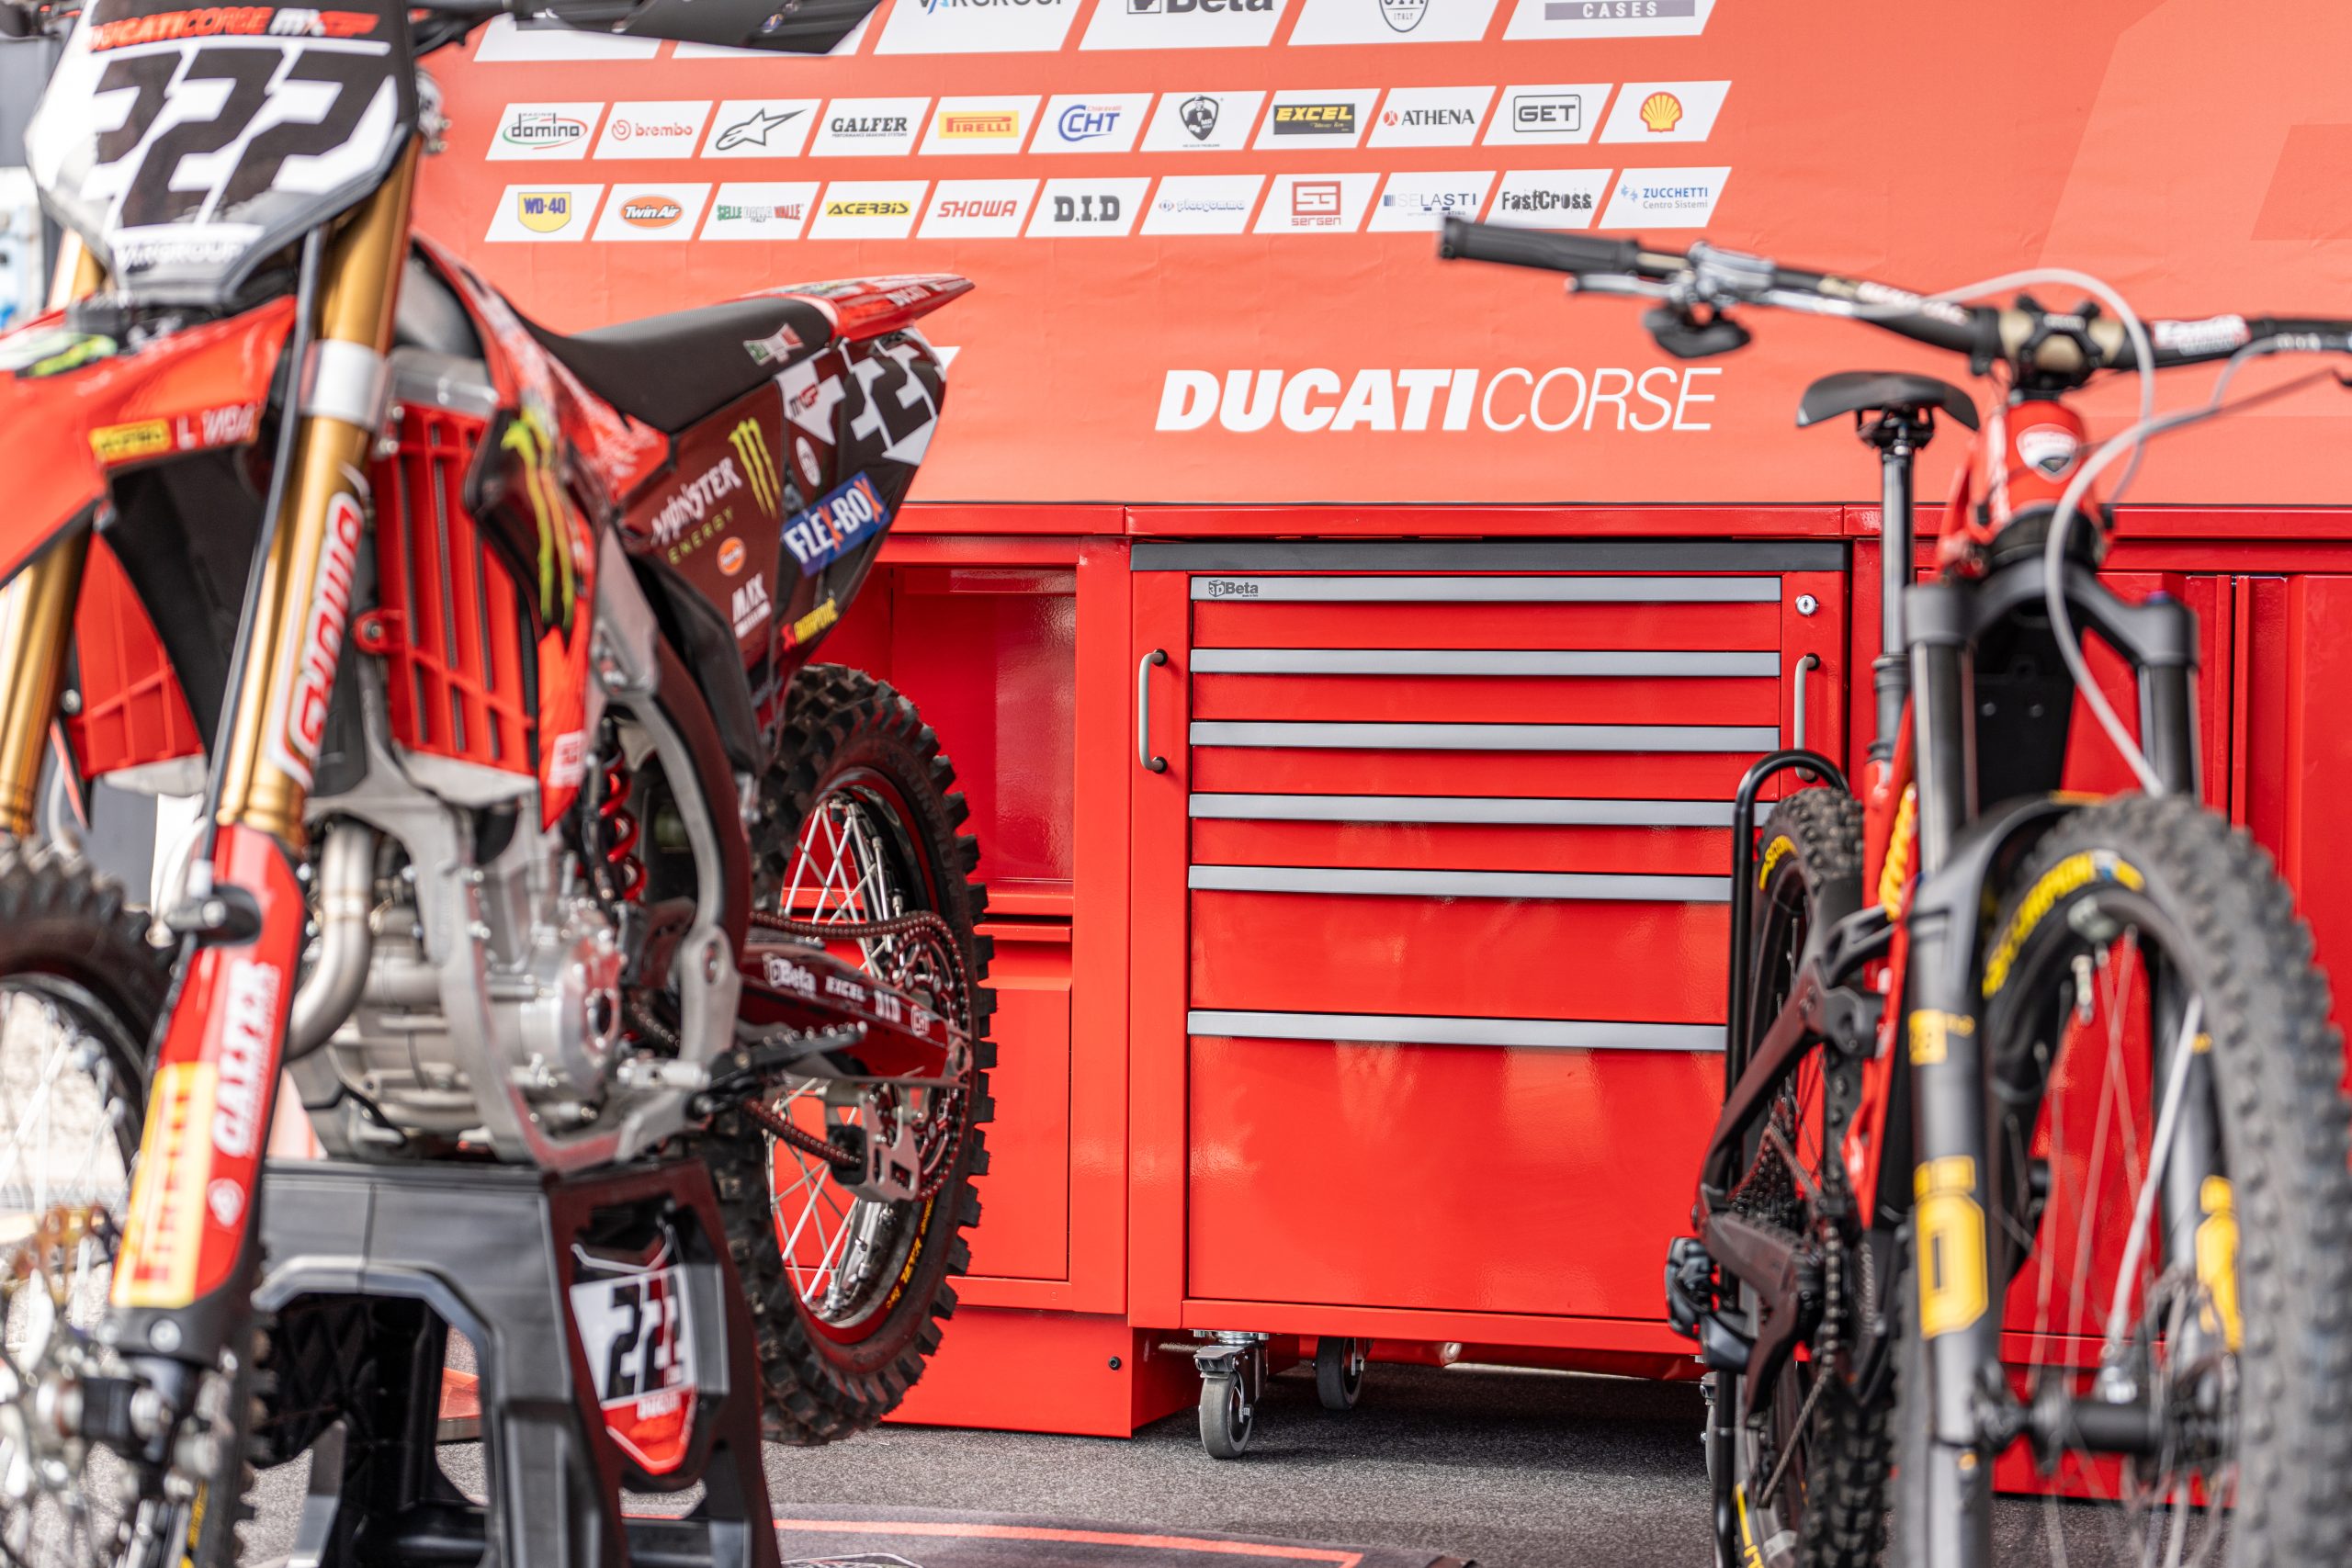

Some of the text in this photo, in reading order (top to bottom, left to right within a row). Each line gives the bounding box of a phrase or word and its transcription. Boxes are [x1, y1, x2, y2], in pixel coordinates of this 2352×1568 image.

[1582, 1, 1658, 18] CASES
[1275, 106, 1353, 121] EXCEL
[1401, 108, 1476, 126] ATHENA
[1519, 105, 1577, 122] GET
[512, 113, 580, 137] domino
[635, 122, 693, 137] brembo
[831, 117, 908, 132] GALFER
[946, 117, 1012, 133] PIRELLI
[1068, 112, 1120, 132] CHT
[1501, 189, 1592, 211] FastCross
[1643, 186, 1708, 198] ZUCCHETTI
[937, 200, 1018, 218] SHOWA
[1054, 196, 1120, 222] D.I.D
[1643, 198, 1708, 210] Centro Sistemi
[624, 206, 682, 220] Twin Air
[1225, 581, 1259, 594] Beta
